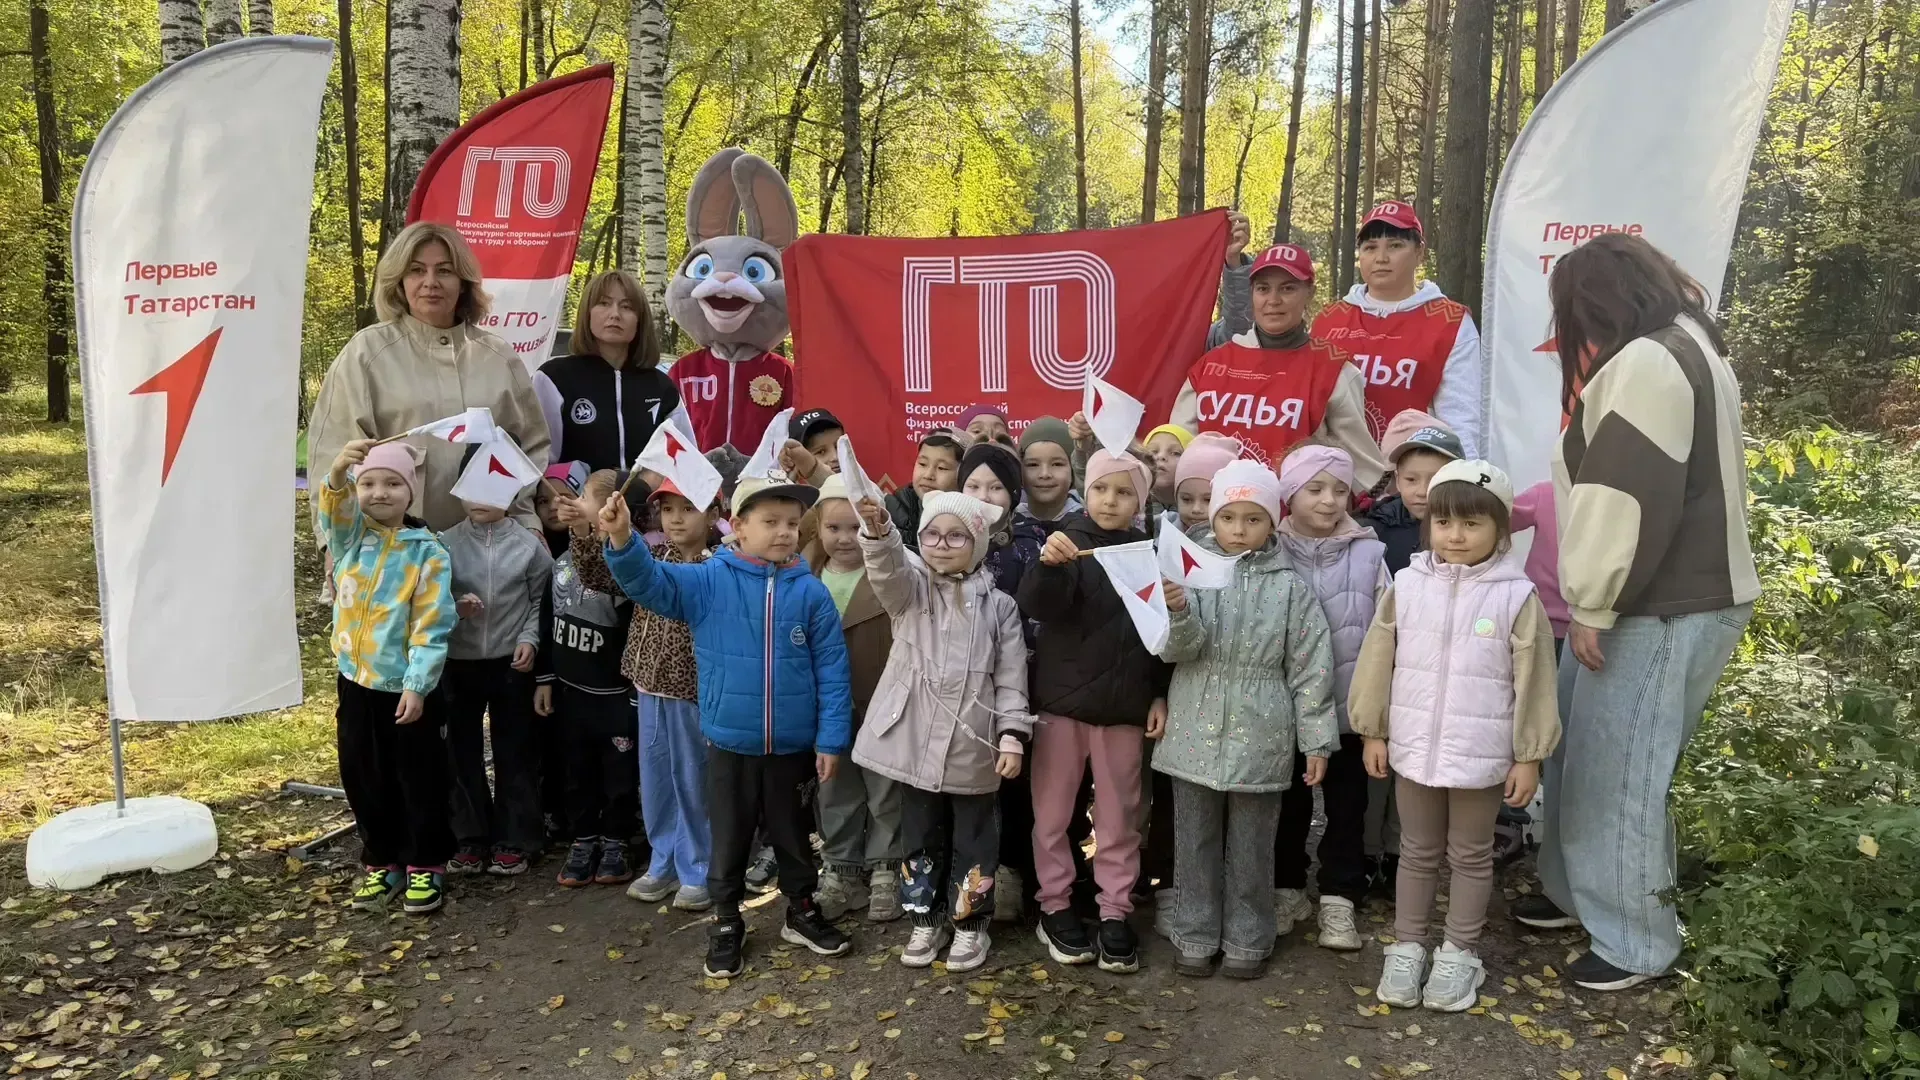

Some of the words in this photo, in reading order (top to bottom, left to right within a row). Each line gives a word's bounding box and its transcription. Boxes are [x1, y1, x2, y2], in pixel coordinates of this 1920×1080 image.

[457, 146, 571, 219] ГТО
[455, 219, 509, 229] Всероссийский
[485, 239, 505, 247] труду
[125, 261, 218, 285] Первые
[124, 293, 256, 317] Татарстан
[503, 311, 539, 327] ГТО
[903, 249, 1116, 392] ГТО
[1353, 353, 1418, 389] ДЬЯ
[800, 411, 820, 426] NYC
[1196, 390, 1304, 429] СУДЬЯ
[1476, 472, 1492, 487] P
[567, 623, 605, 653] DEP
